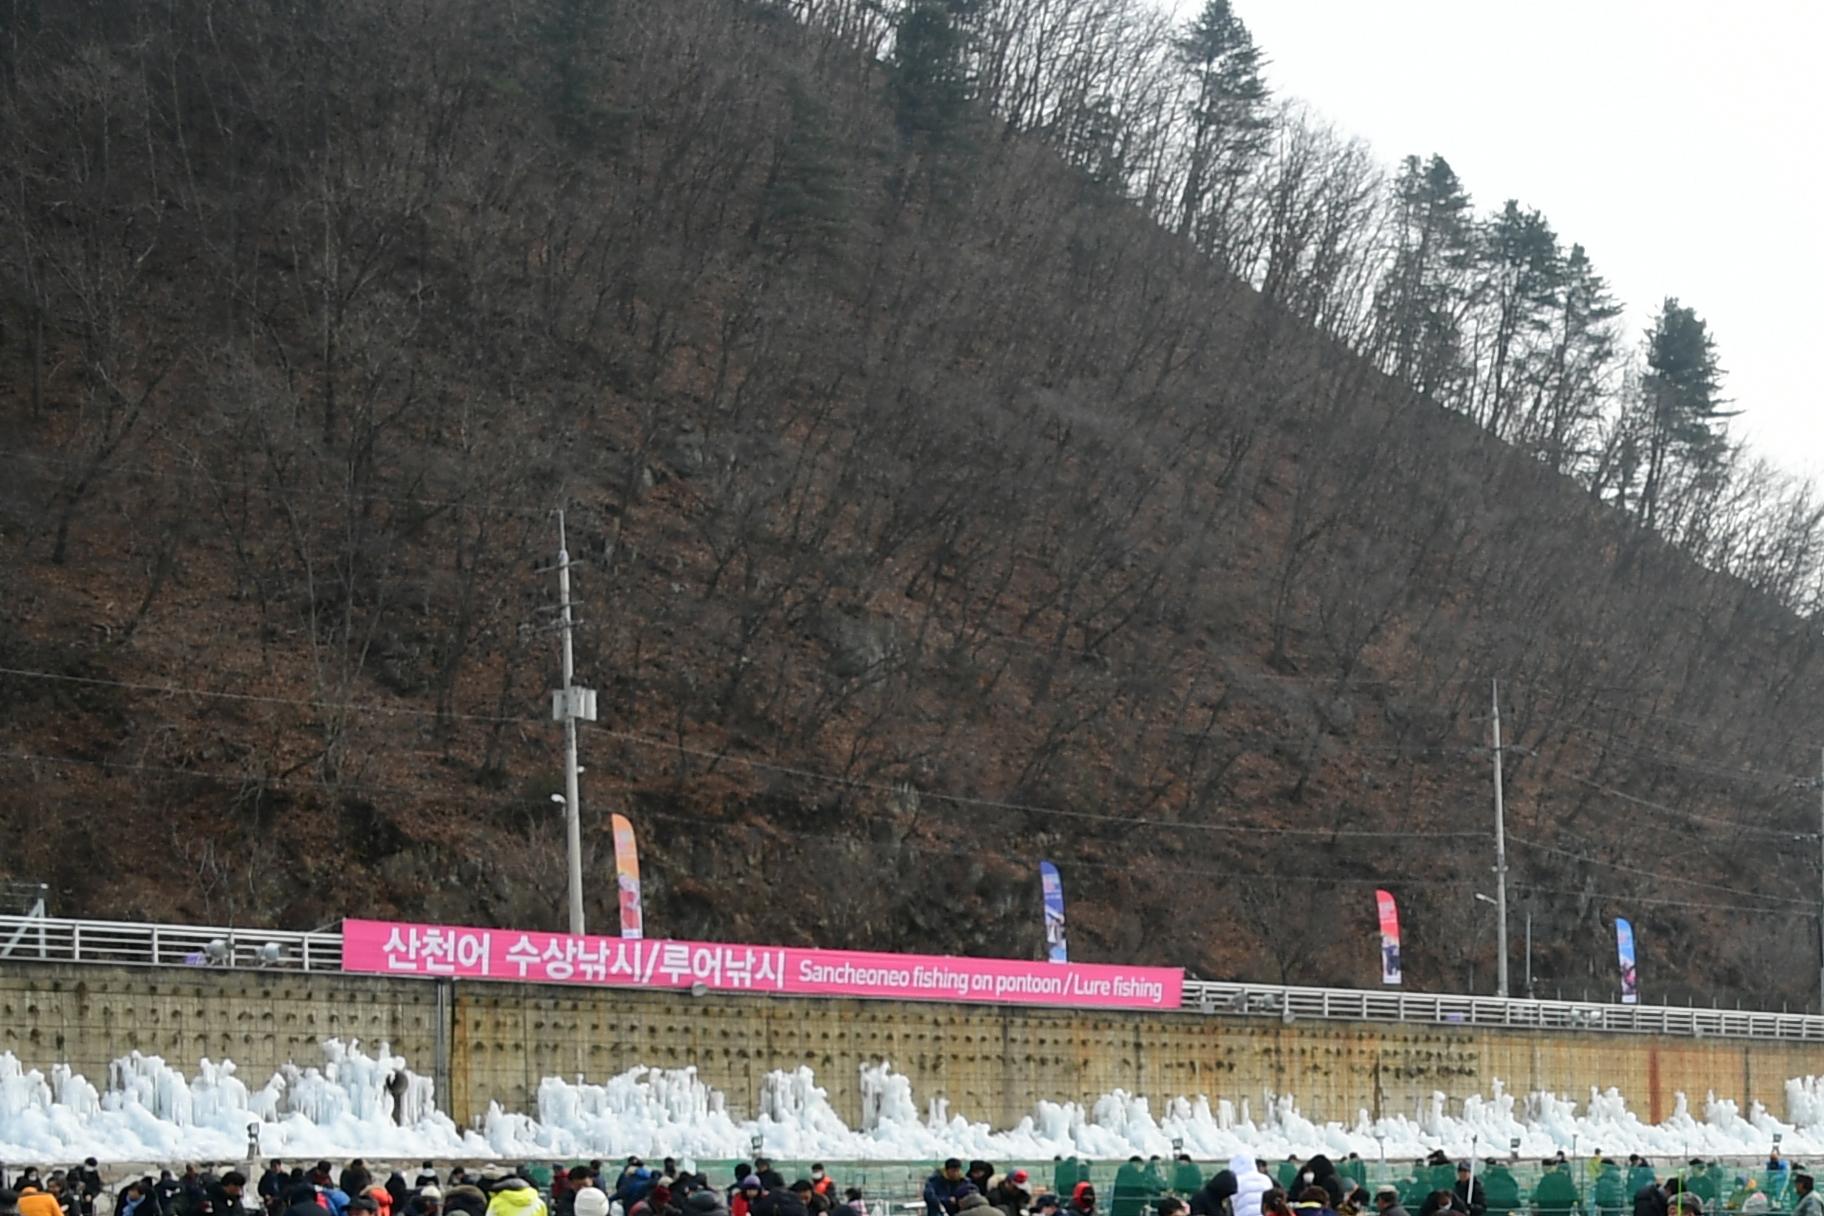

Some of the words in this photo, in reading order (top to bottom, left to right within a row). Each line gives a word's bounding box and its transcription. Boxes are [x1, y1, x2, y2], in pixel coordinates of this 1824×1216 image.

[382, 927, 490, 975] 산천어
[799, 959, 909, 987] Sancheoneo
[912, 966, 968, 994] fishing
[972, 974, 993, 991] on
[1113, 976, 1163, 1002] fishing
